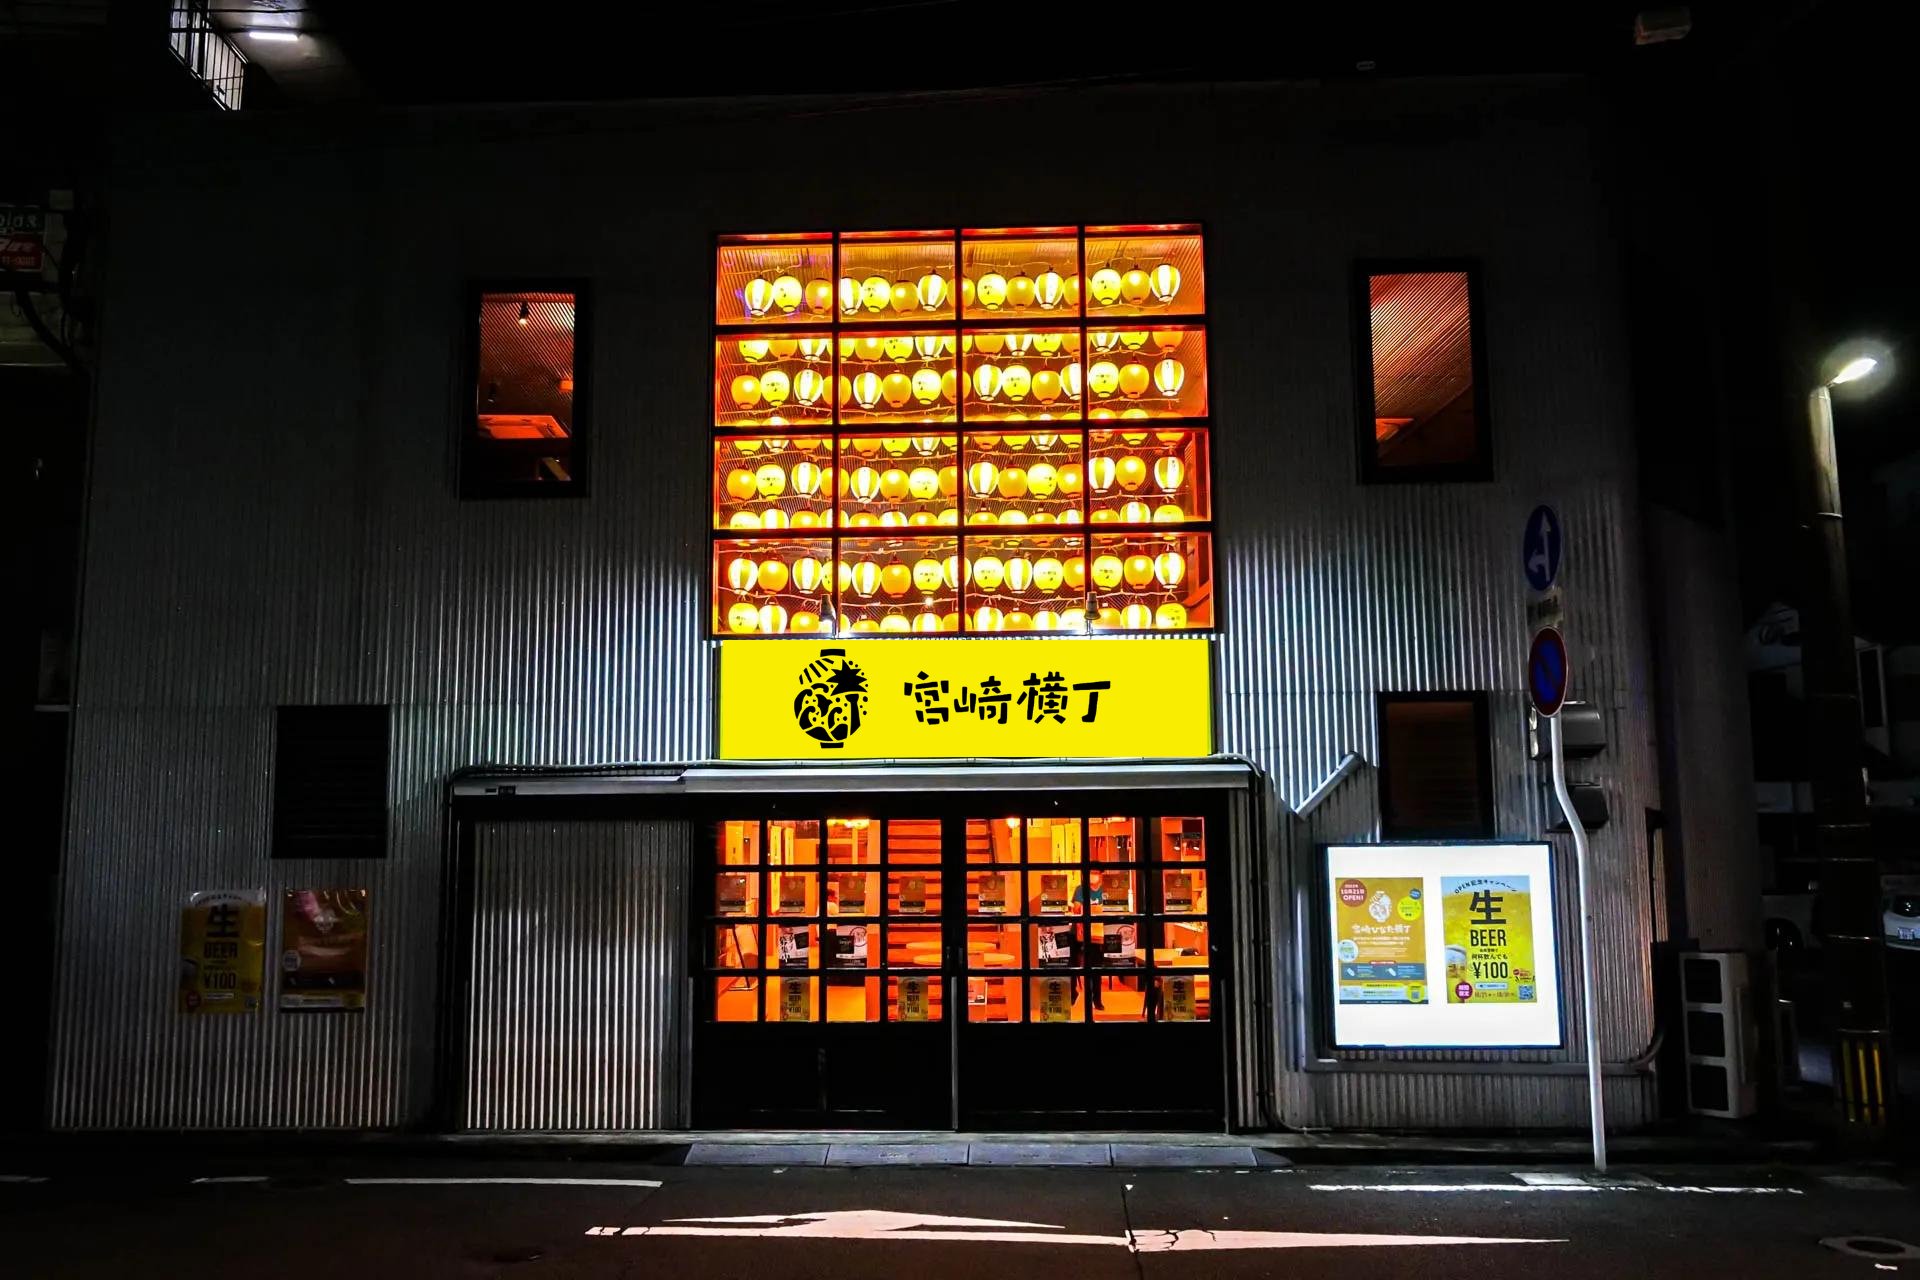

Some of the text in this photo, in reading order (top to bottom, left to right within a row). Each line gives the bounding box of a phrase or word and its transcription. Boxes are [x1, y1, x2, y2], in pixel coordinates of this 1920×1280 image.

[903, 670, 1111, 725] 宮崎横丁
[206, 903, 240, 938] 生
[1469, 889, 1506, 924] 生
[1470, 929, 1507, 947] BEER
[1473, 961, 1509, 979] ¥100
